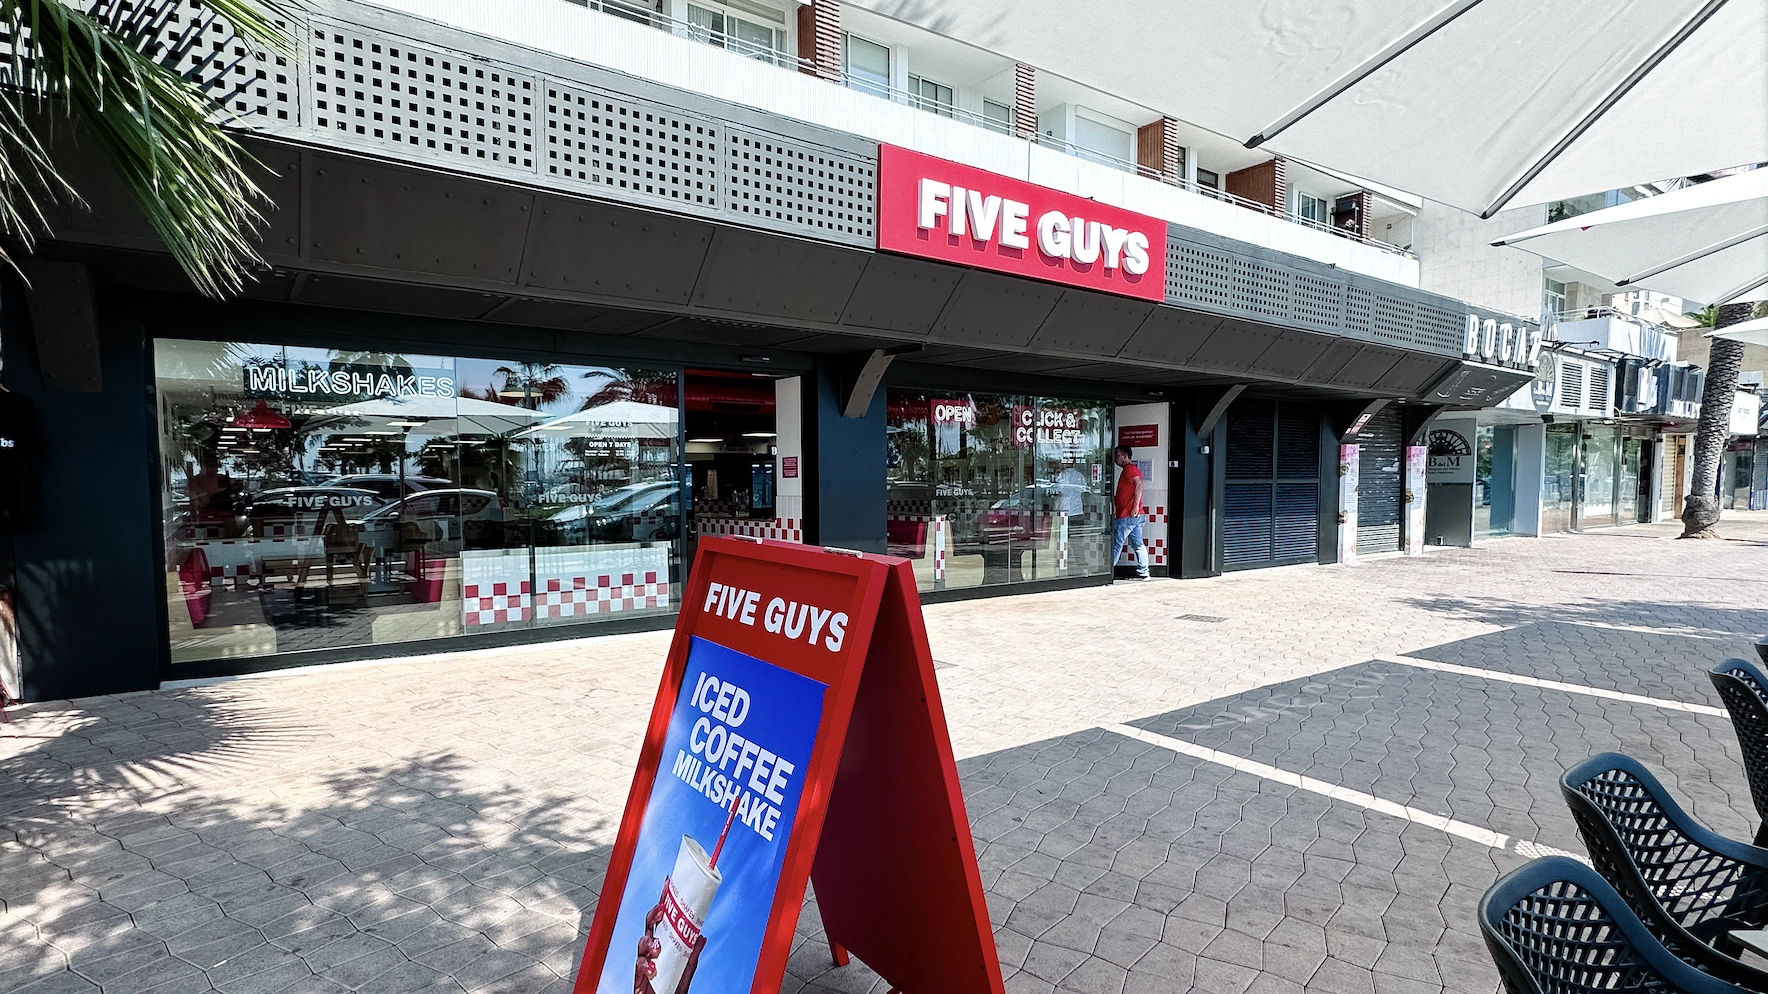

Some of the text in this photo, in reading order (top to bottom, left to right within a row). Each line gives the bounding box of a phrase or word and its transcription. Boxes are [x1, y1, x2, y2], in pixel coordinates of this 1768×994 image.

[918, 177, 1149, 275] FIVE GUYS
[250, 366, 455, 399] MILKSHAKES
[935, 404, 972, 422] OPEN
[287, 495, 373, 508] FIVE GUYS
[539, 493, 602, 503] FIVE GUYS
[936, 488, 973, 497] FIVE GUYS
[703, 582, 849, 652] FIVE GUYS
[690, 671, 750, 728] ICED
[689, 716, 795, 806] COFFEE
[671, 749, 781, 842] MILKSHAKE
[676, 918, 699, 946] GUYS
